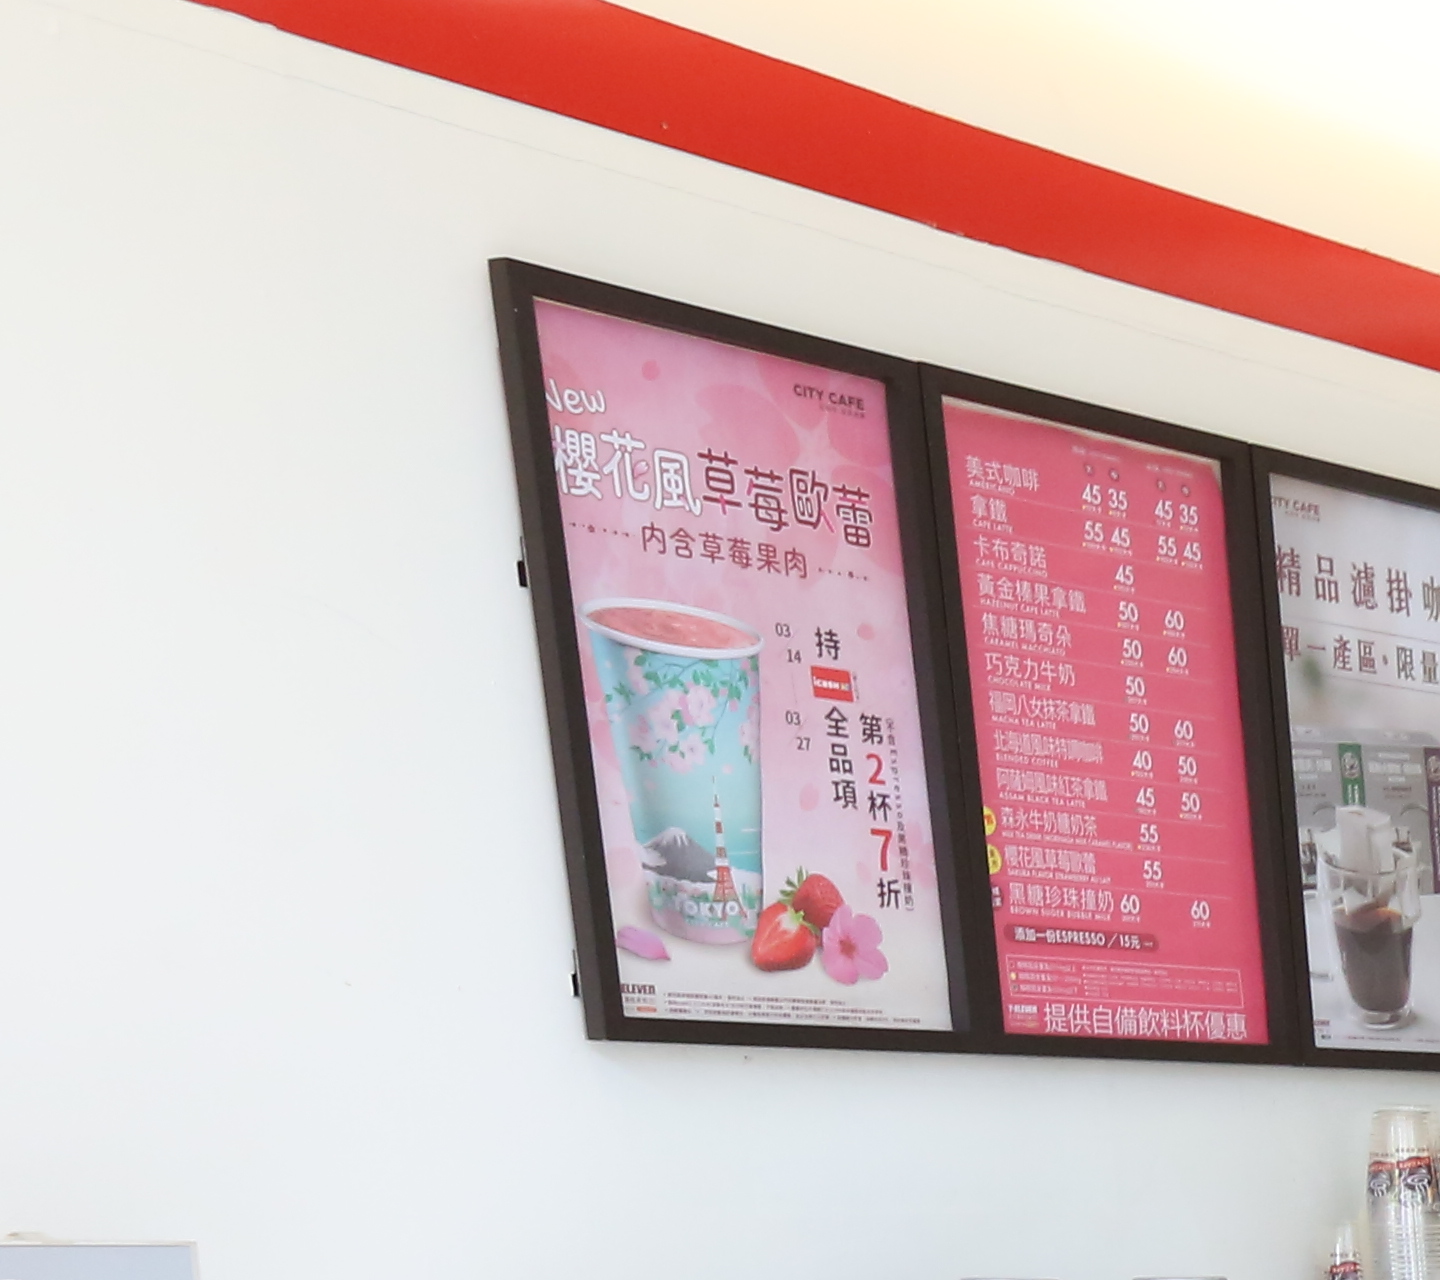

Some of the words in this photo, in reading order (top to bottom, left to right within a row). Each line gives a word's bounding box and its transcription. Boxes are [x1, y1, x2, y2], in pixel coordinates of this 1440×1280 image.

[793, 383, 825, 400] CITY
[828, 392, 865, 410] CAFE
[965, 455, 1040, 491] 美式咖啡
[551, 424, 874, 551] 櫻花風草莓歐蕾
[1082, 483, 1102, 504] 45
[970, 494, 1008, 523] 拿鐵
[1108, 488, 1128, 510] 35
[1293, 497, 1320, 514] CAFE
[1155, 501, 1173, 520] 45
[1179, 504, 1198, 525] 35
[1084, 521, 1104, 542] 55
[1110, 527, 1131, 547] 45
[973, 534, 1047, 569] 卡布奇諾
[1157, 536, 1177, 556] 55
[1183, 542, 1201, 562] 45
[1115, 564, 1135, 585] 45
[1118, 601, 1138, 622] 50
[1164, 610, 1184, 630] 60
[981, 612, 1072, 647] 焦糖瑪奇朵
[814, 626, 841, 661] 持
[1122, 639, 1142, 660] 50
[1168, 647, 1187, 667] 60
[984, 652, 1076, 687] 巧克力牛奶
[1125, 676, 1146, 697] 50
[1129, 713, 1149, 733] 50
[1174, 719, 1194, 740] 60
[824, 707, 859, 810] 全品項
[1132, 750, 1153, 770] 40
[1178, 756, 1197, 776] 50
[1136, 788, 1155, 808] 45
[1181, 793, 1200, 813] 50
[859, 714, 902, 910] 第2杯7折
[1139, 824, 1159, 844] 55
[1143, 861, 1163, 881] 55
[1120, 895, 1140, 914] 60
[1191, 900, 1210, 921] 60
[1043, 1003, 1247, 1040] 提供自備飲料杯優惠
